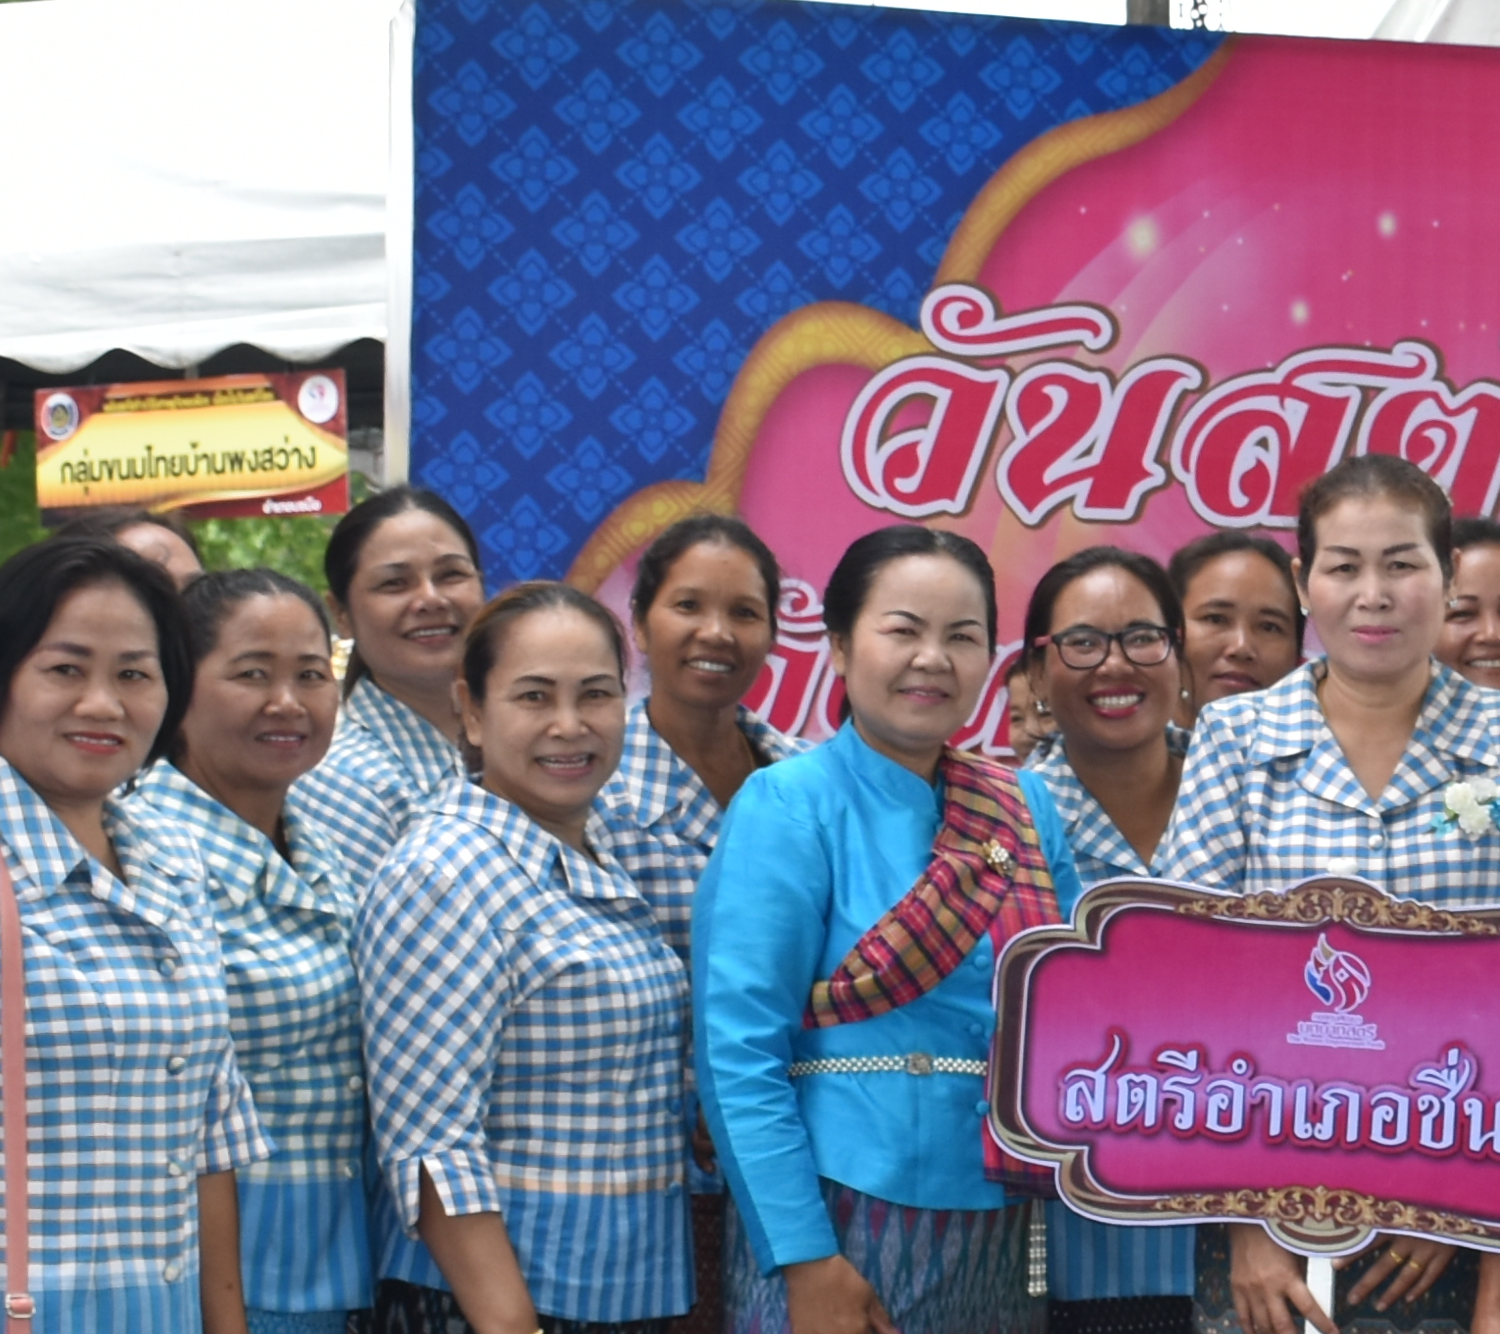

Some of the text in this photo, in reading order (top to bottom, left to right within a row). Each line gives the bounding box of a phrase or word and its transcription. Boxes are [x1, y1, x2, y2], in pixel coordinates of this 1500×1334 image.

[59, 436, 317, 496] กลุ่มขนมไทยบ้านพงสว่าง
